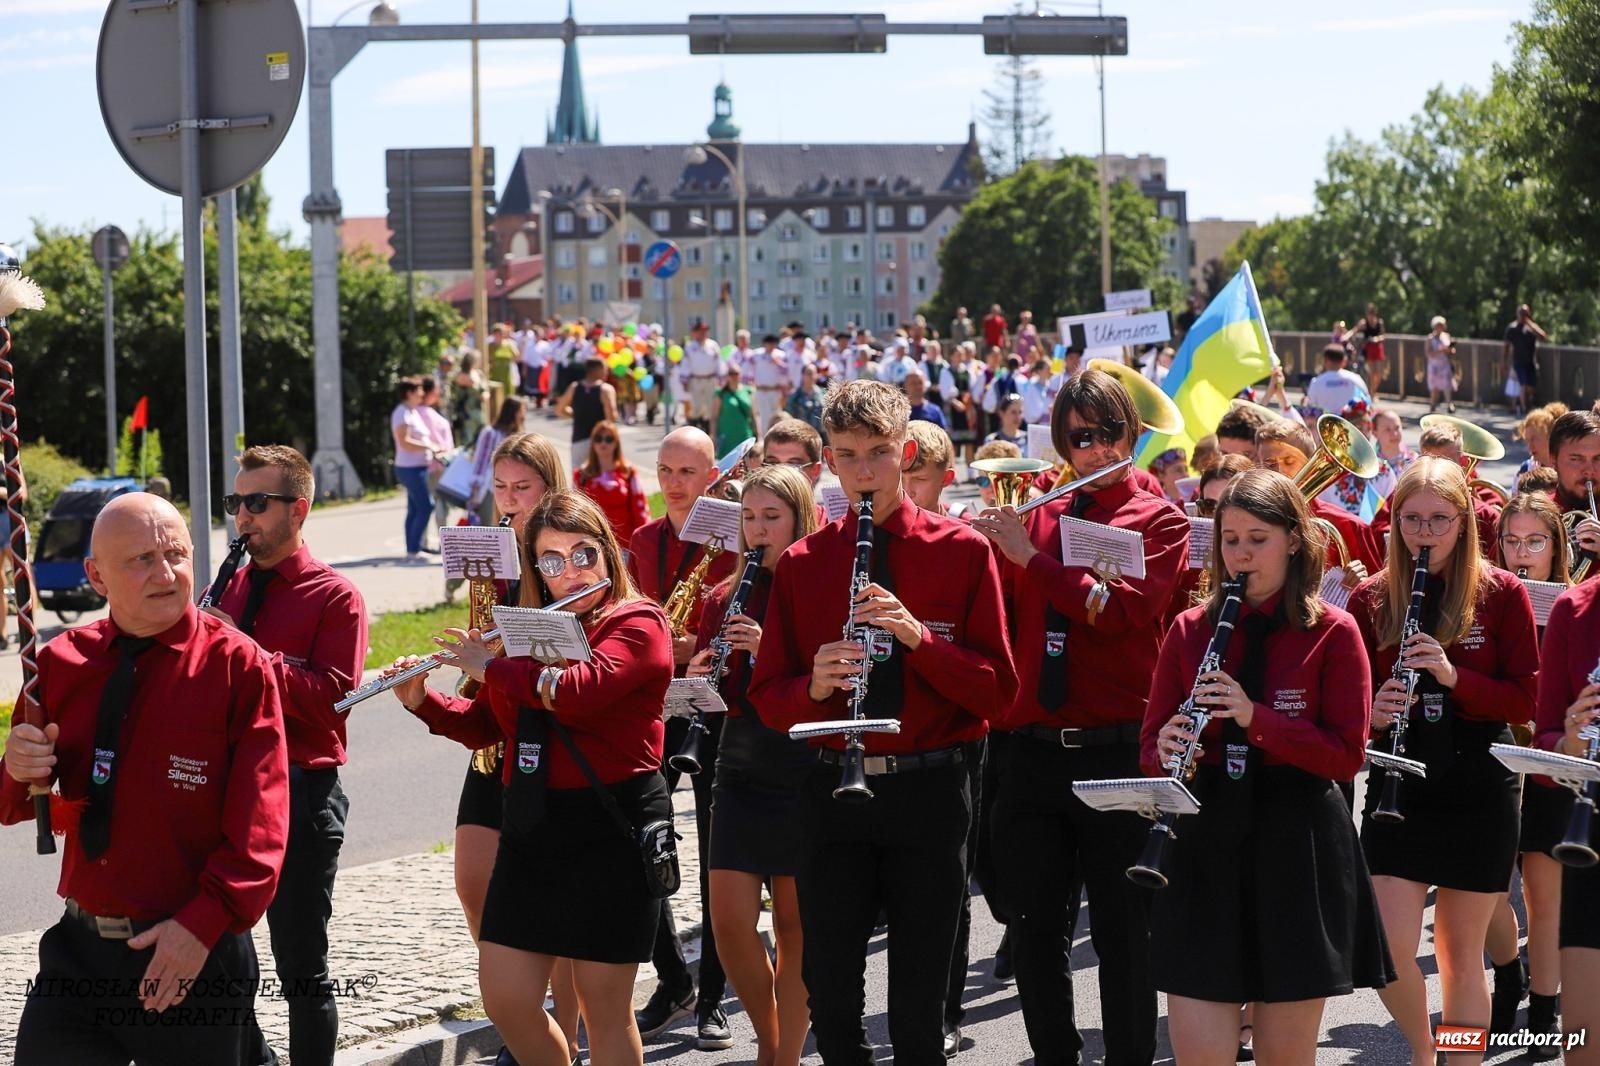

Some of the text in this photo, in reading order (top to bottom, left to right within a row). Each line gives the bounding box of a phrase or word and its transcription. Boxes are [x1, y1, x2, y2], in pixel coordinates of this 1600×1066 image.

[1093, 322, 1160, 344] Ukraina
[1273, 700, 1307, 710] Silenzio
[167, 769, 208, 785] Silenzio
